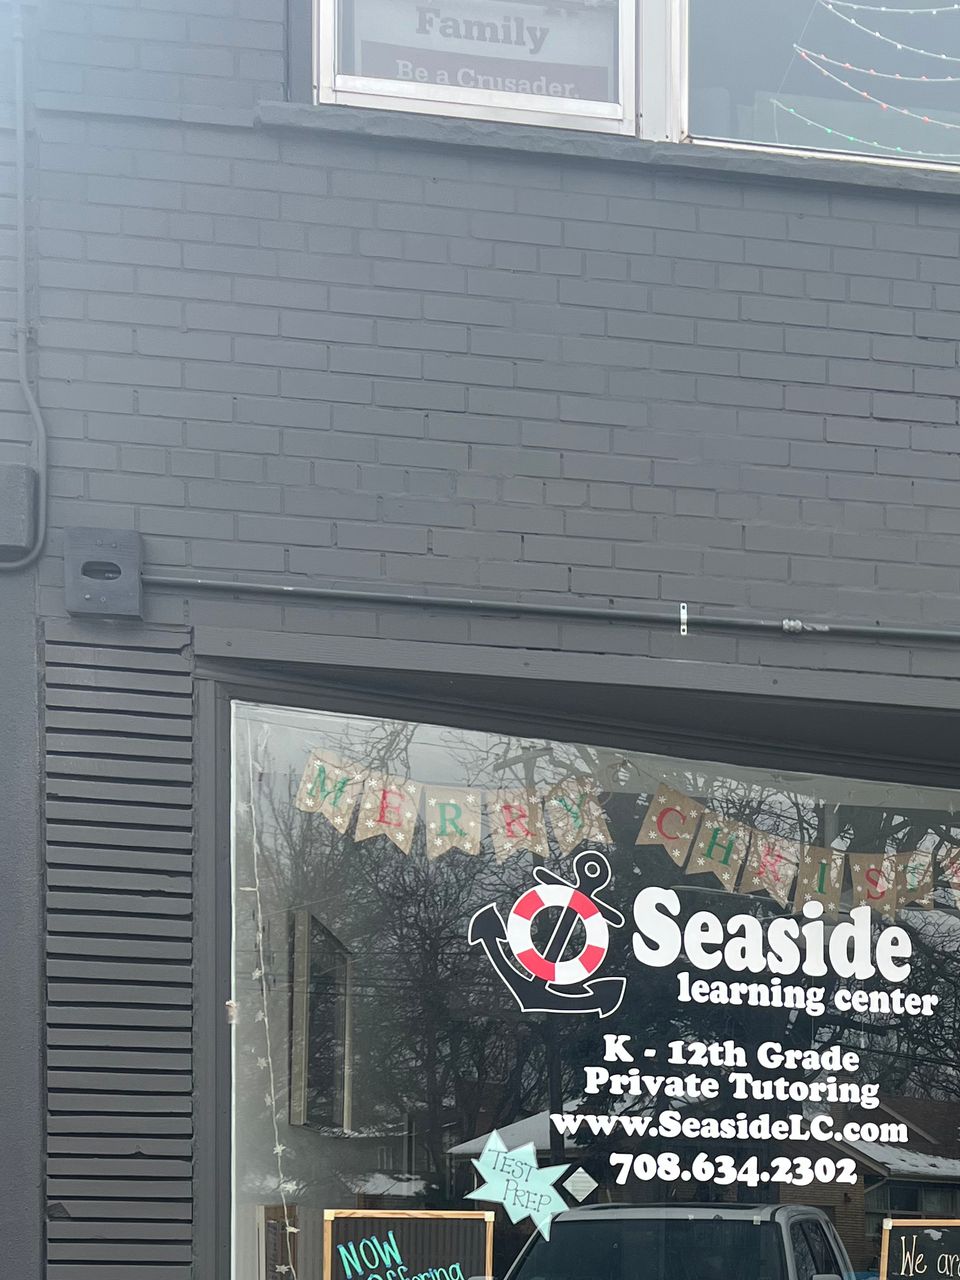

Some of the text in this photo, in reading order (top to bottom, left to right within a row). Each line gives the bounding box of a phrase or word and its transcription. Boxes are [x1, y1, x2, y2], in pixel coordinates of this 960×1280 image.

[415, 6, 550, 55] Family
[395, 59, 580, 98] Be a Crusader.
[306, 764, 588, 839] MERRY
[631, 885, 913, 982] Seaside
[676, 971, 939, 1016] learning center
[602, 1033, 634, 1063] K
[667, 1039, 748, 1068] 12th
[757, 1041, 860, 1072] Grade
[583, 1066, 880, 1109] Private Tutoring
[549, 1110, 909, 1143] www.SeasideLC.com
[487, 1148, 540, 1182] TEST
[609, 1152, 858, 1187] 708.634.2302
[502, 1178, 552, 1213] PREP
[336, 1230, 404, 1280] NOW
[900, 1234, 928, 1277] We
